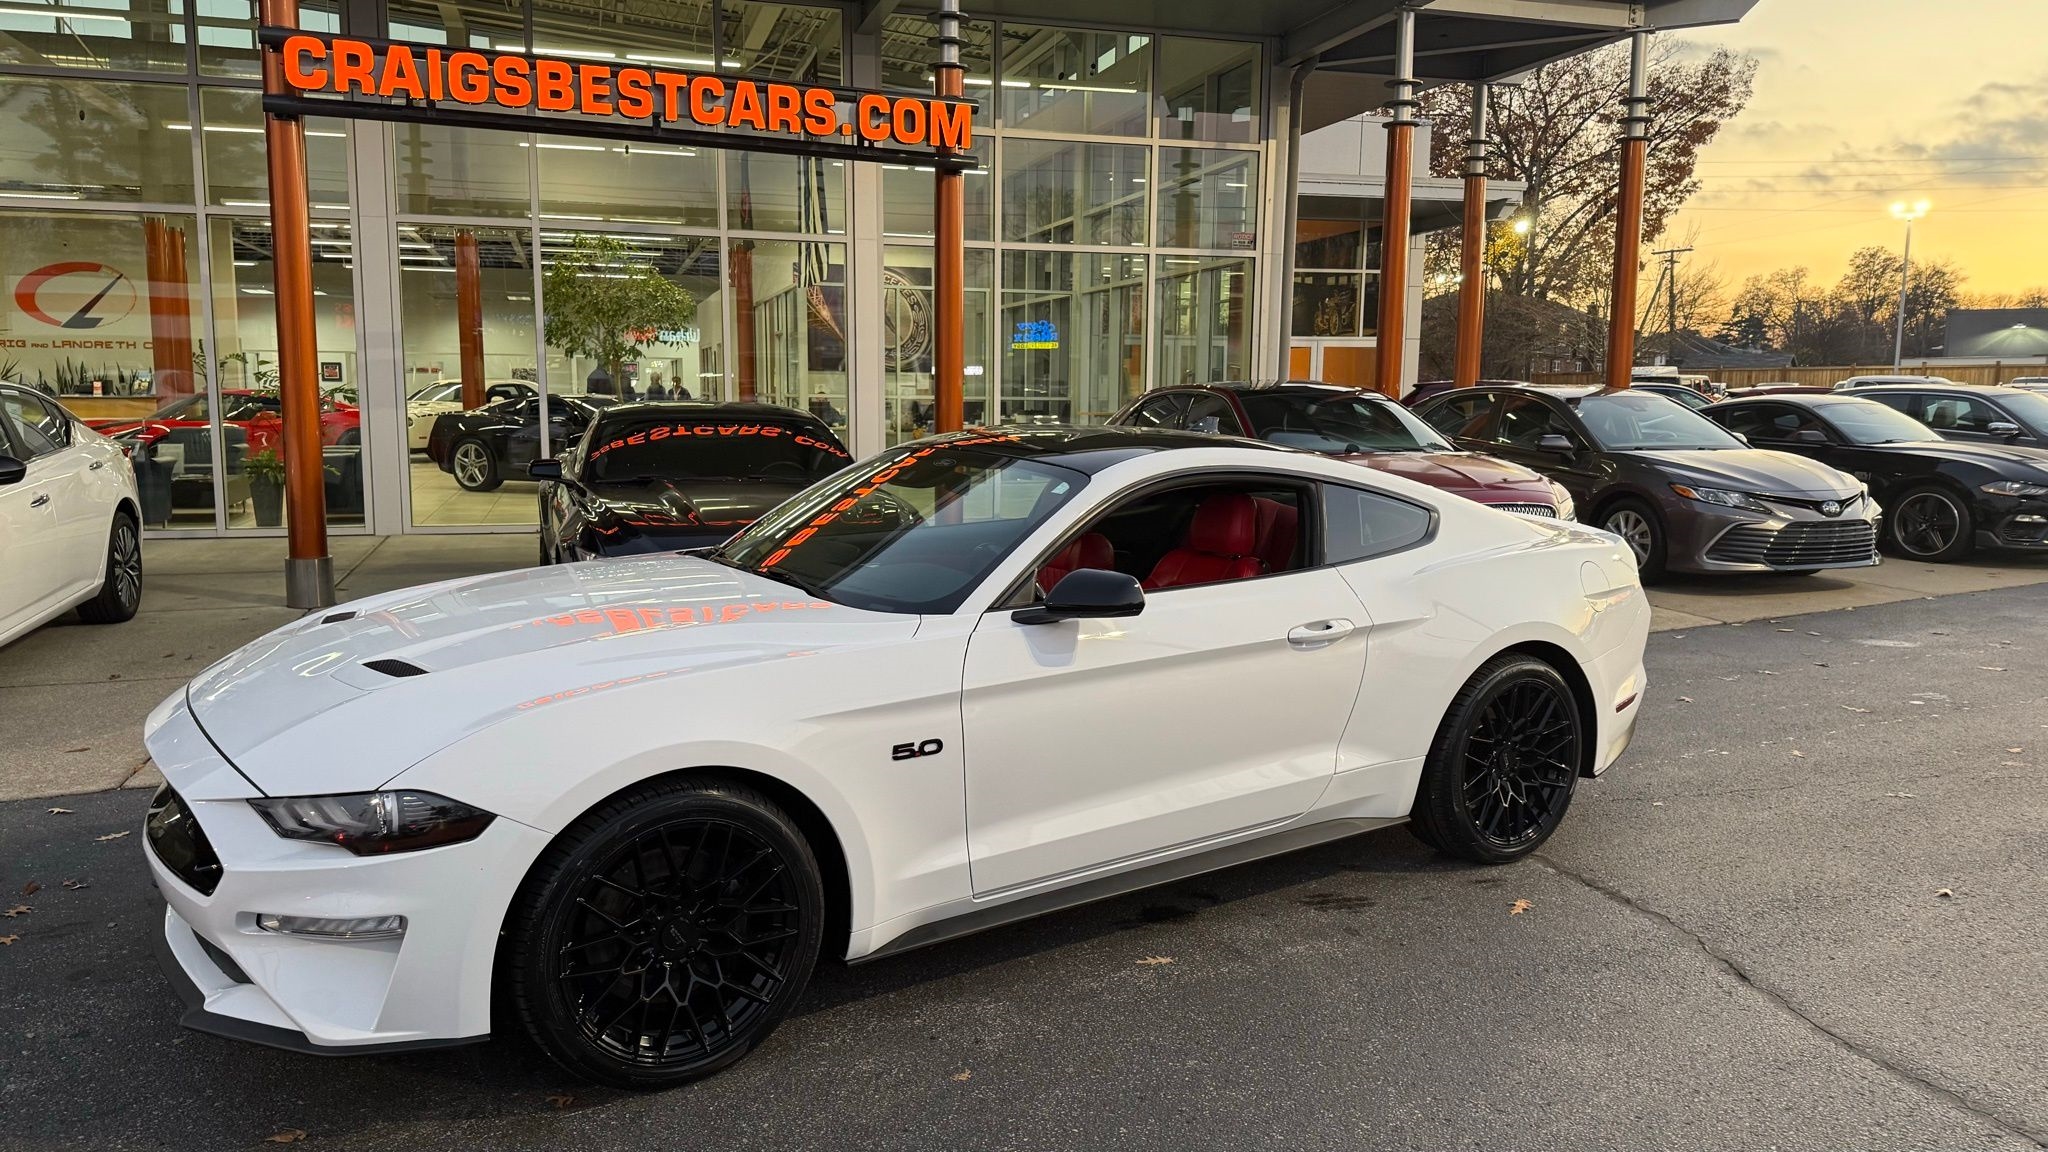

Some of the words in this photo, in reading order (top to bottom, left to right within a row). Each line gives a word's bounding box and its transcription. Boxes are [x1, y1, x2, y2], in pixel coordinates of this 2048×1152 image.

[283, 35, 972, 150] CRAIGSBESTCARS.COM
[52, 340, 137, 349] LANDRETH
[892, 738, 944, 761] 5.0
